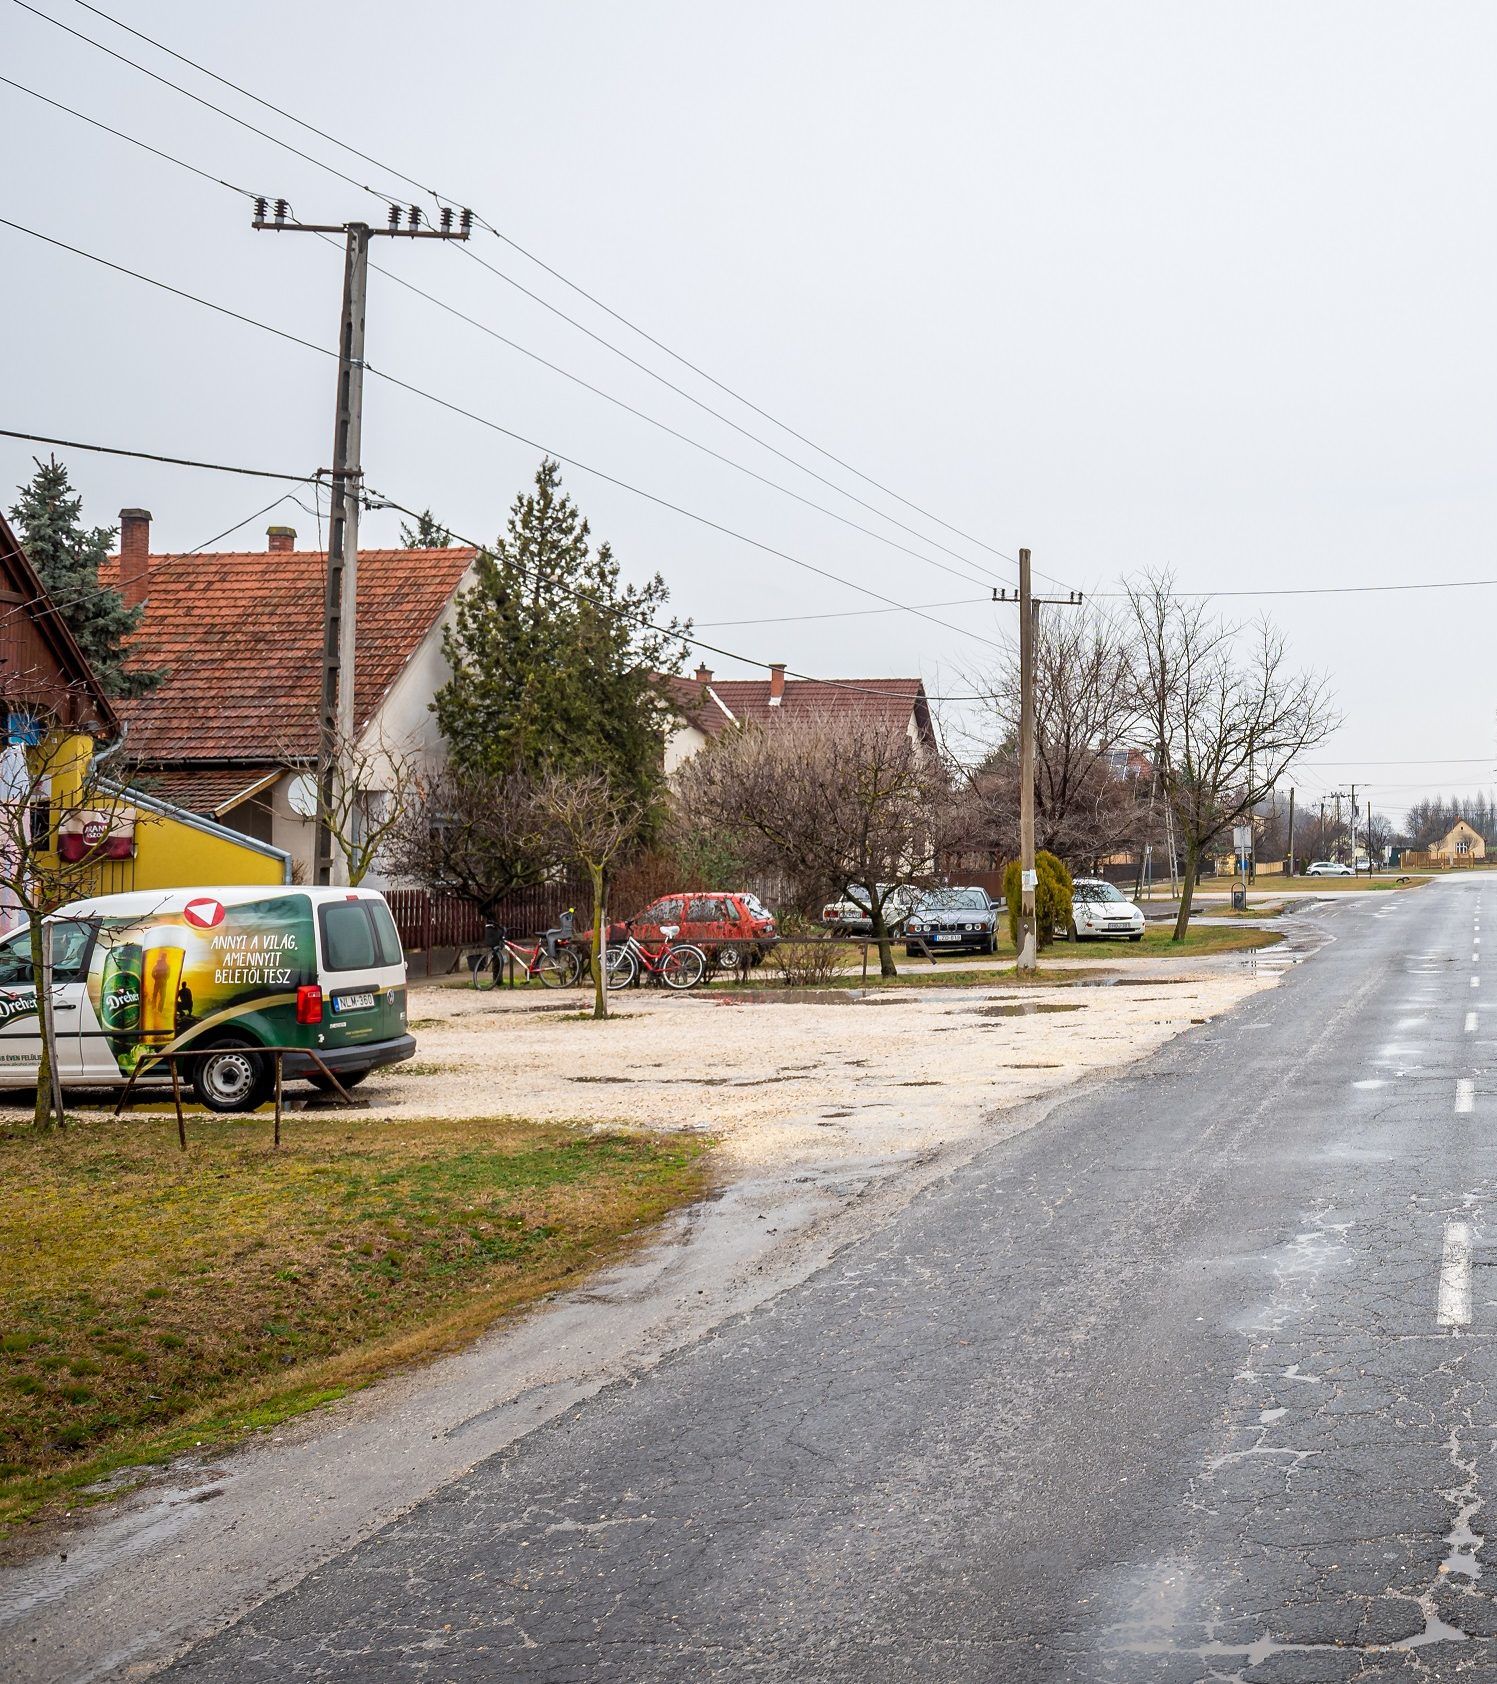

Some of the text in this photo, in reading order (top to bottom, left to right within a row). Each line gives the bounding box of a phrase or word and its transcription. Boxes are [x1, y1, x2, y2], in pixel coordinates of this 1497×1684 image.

[210, 933, 298, 950] ANNYI A VILÁG.
[222, 952, 282, 966] AMENNYIT
[214, 967, 291, 983] BELETÖLTESZ
[106, 991, 140, 1010] Dreher
[340, 994, 373, 1008] NLM-360
